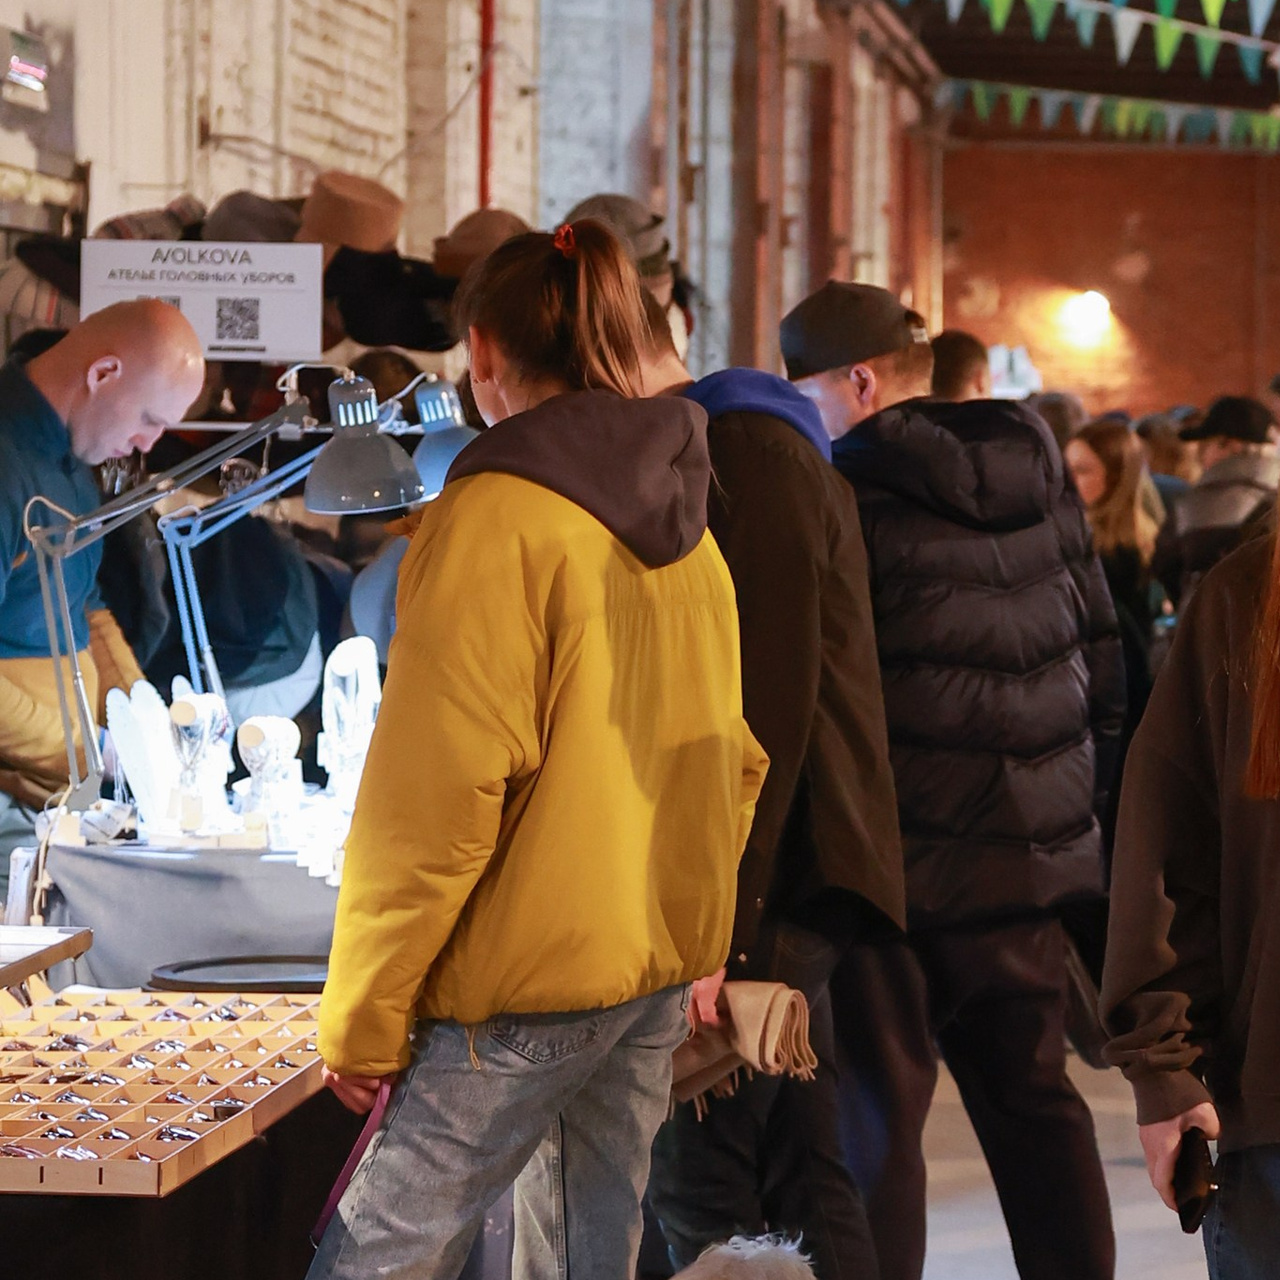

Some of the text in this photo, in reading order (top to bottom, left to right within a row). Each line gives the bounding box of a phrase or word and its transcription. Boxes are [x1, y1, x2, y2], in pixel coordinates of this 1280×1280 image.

[107, 269, 296, 284] АТЕЛЬЕ ГОЛОВНЫХ УБОРОВ
